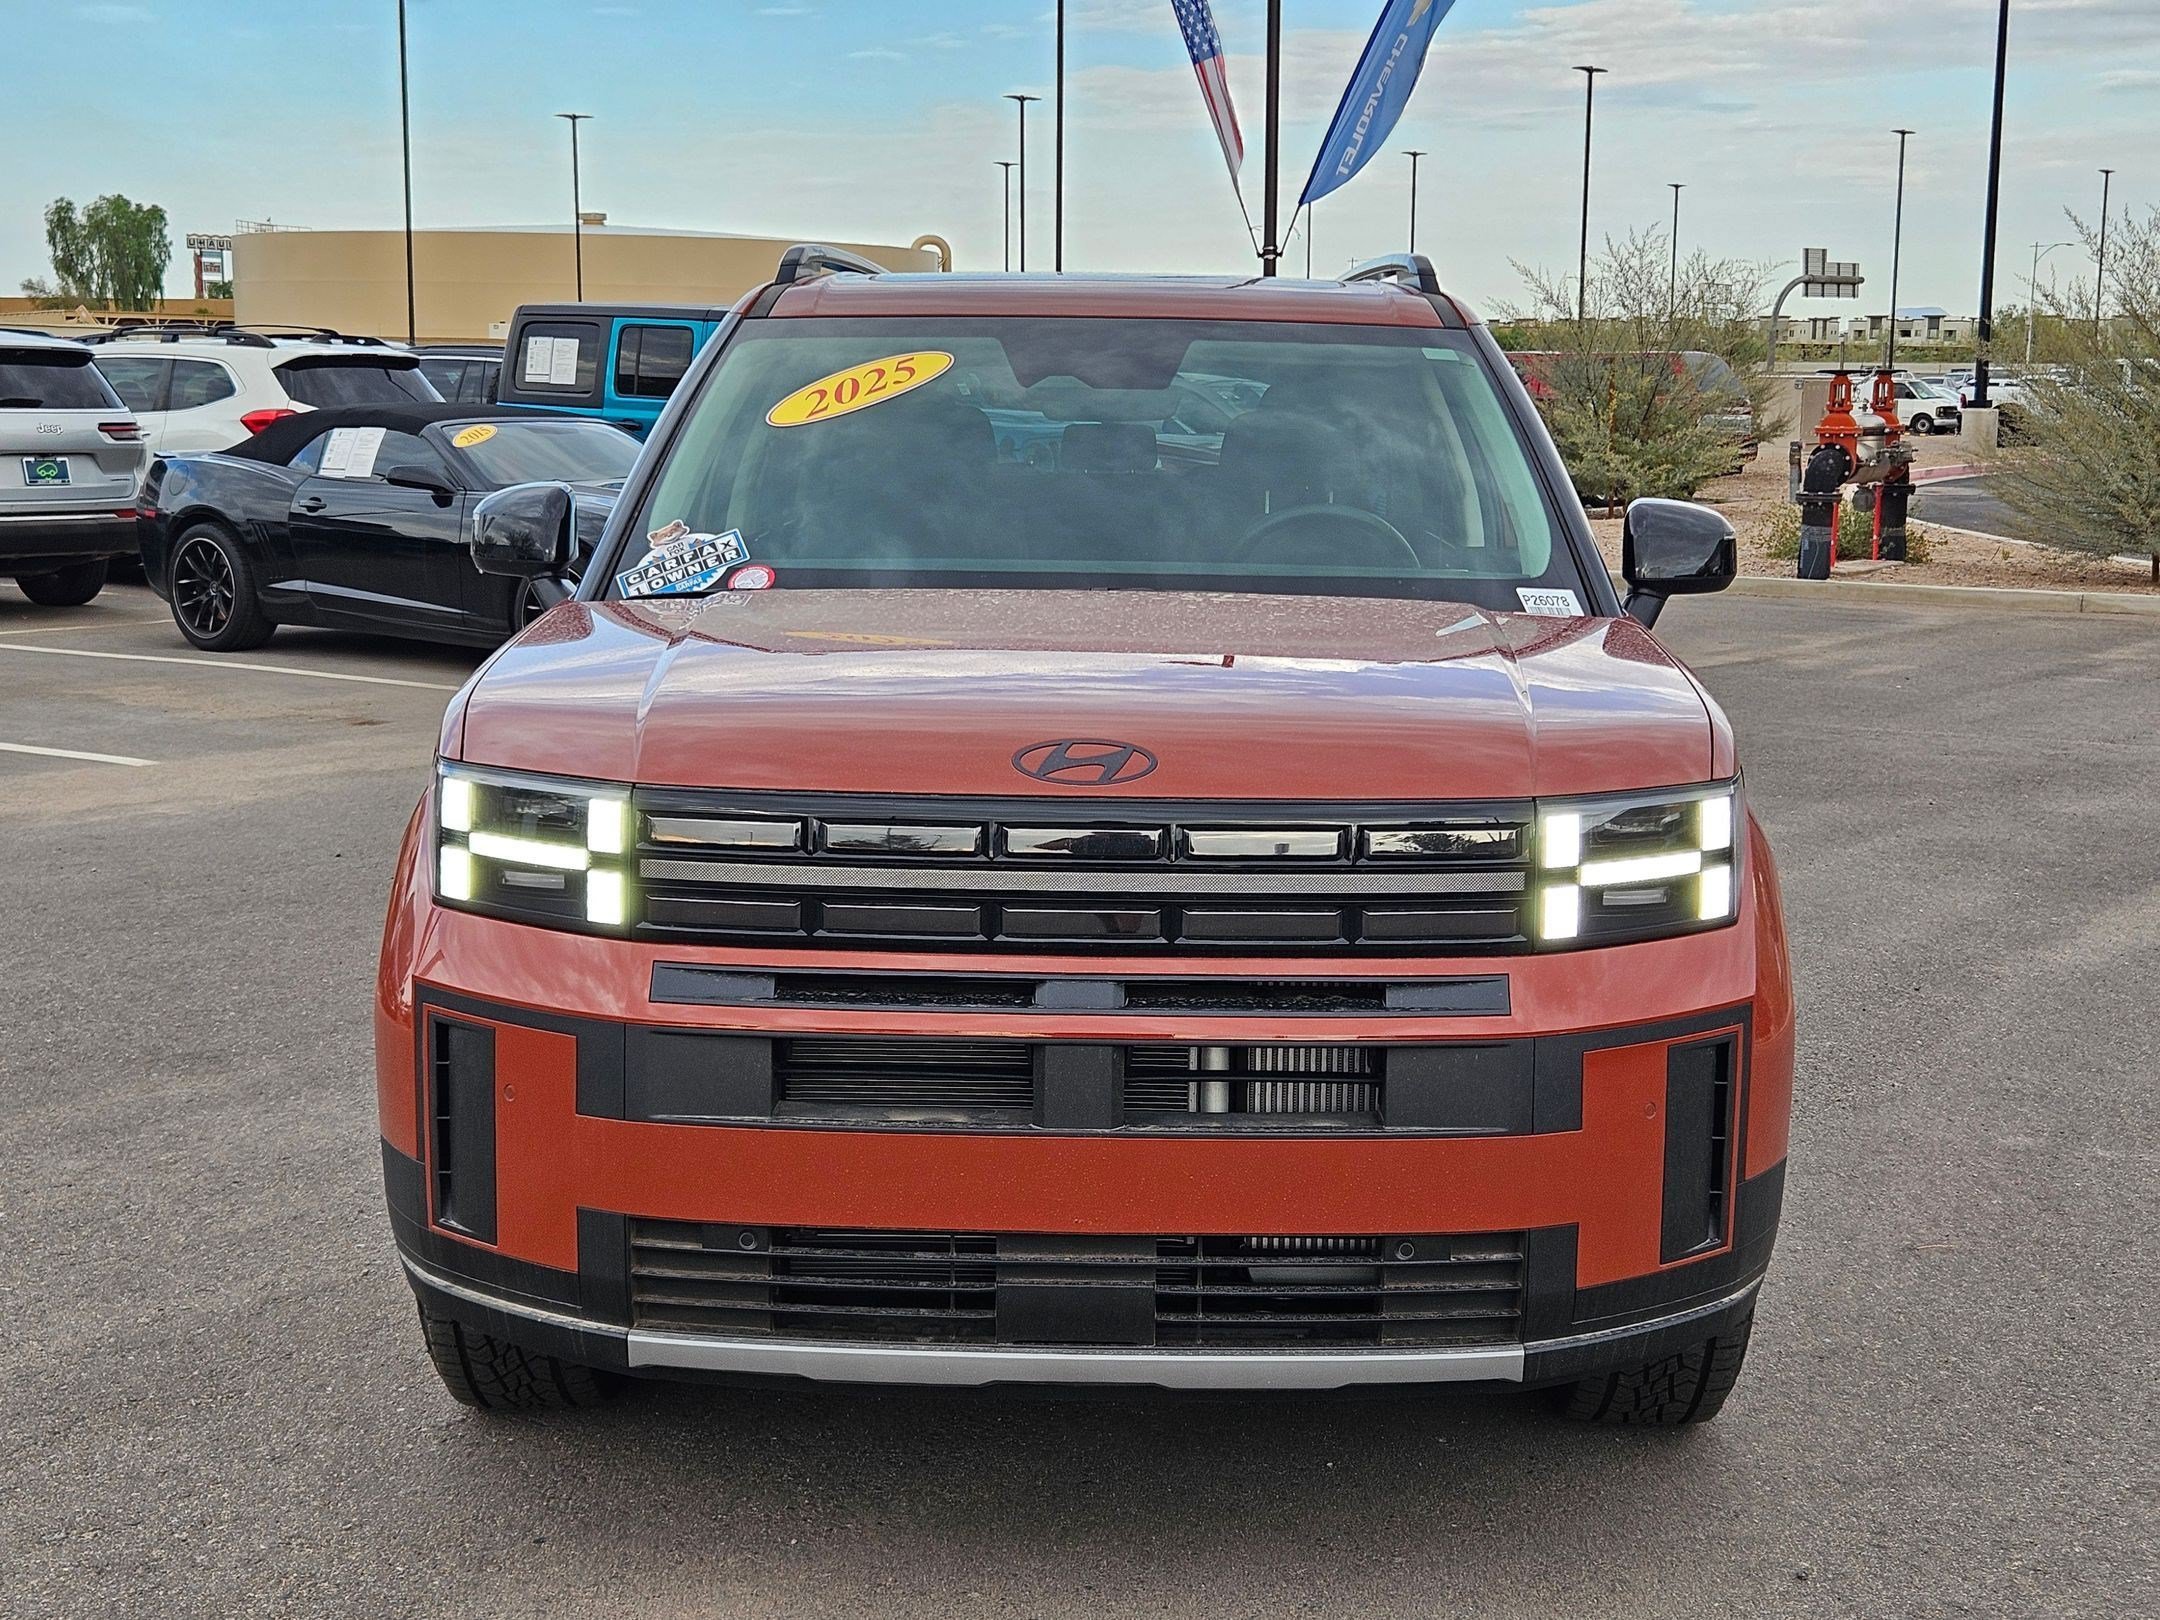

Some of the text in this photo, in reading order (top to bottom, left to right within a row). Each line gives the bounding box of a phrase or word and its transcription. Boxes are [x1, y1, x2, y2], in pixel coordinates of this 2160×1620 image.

[805, 356, 916, 418] 2025
[37, 423, 63, 435] Jeep
[460, 427, 491, 443] 2015
[627, 539, 734, 584] CARFAX
[650, 550, 739, 589] OWNER
[1522, 594, 1570, 607] P26078
